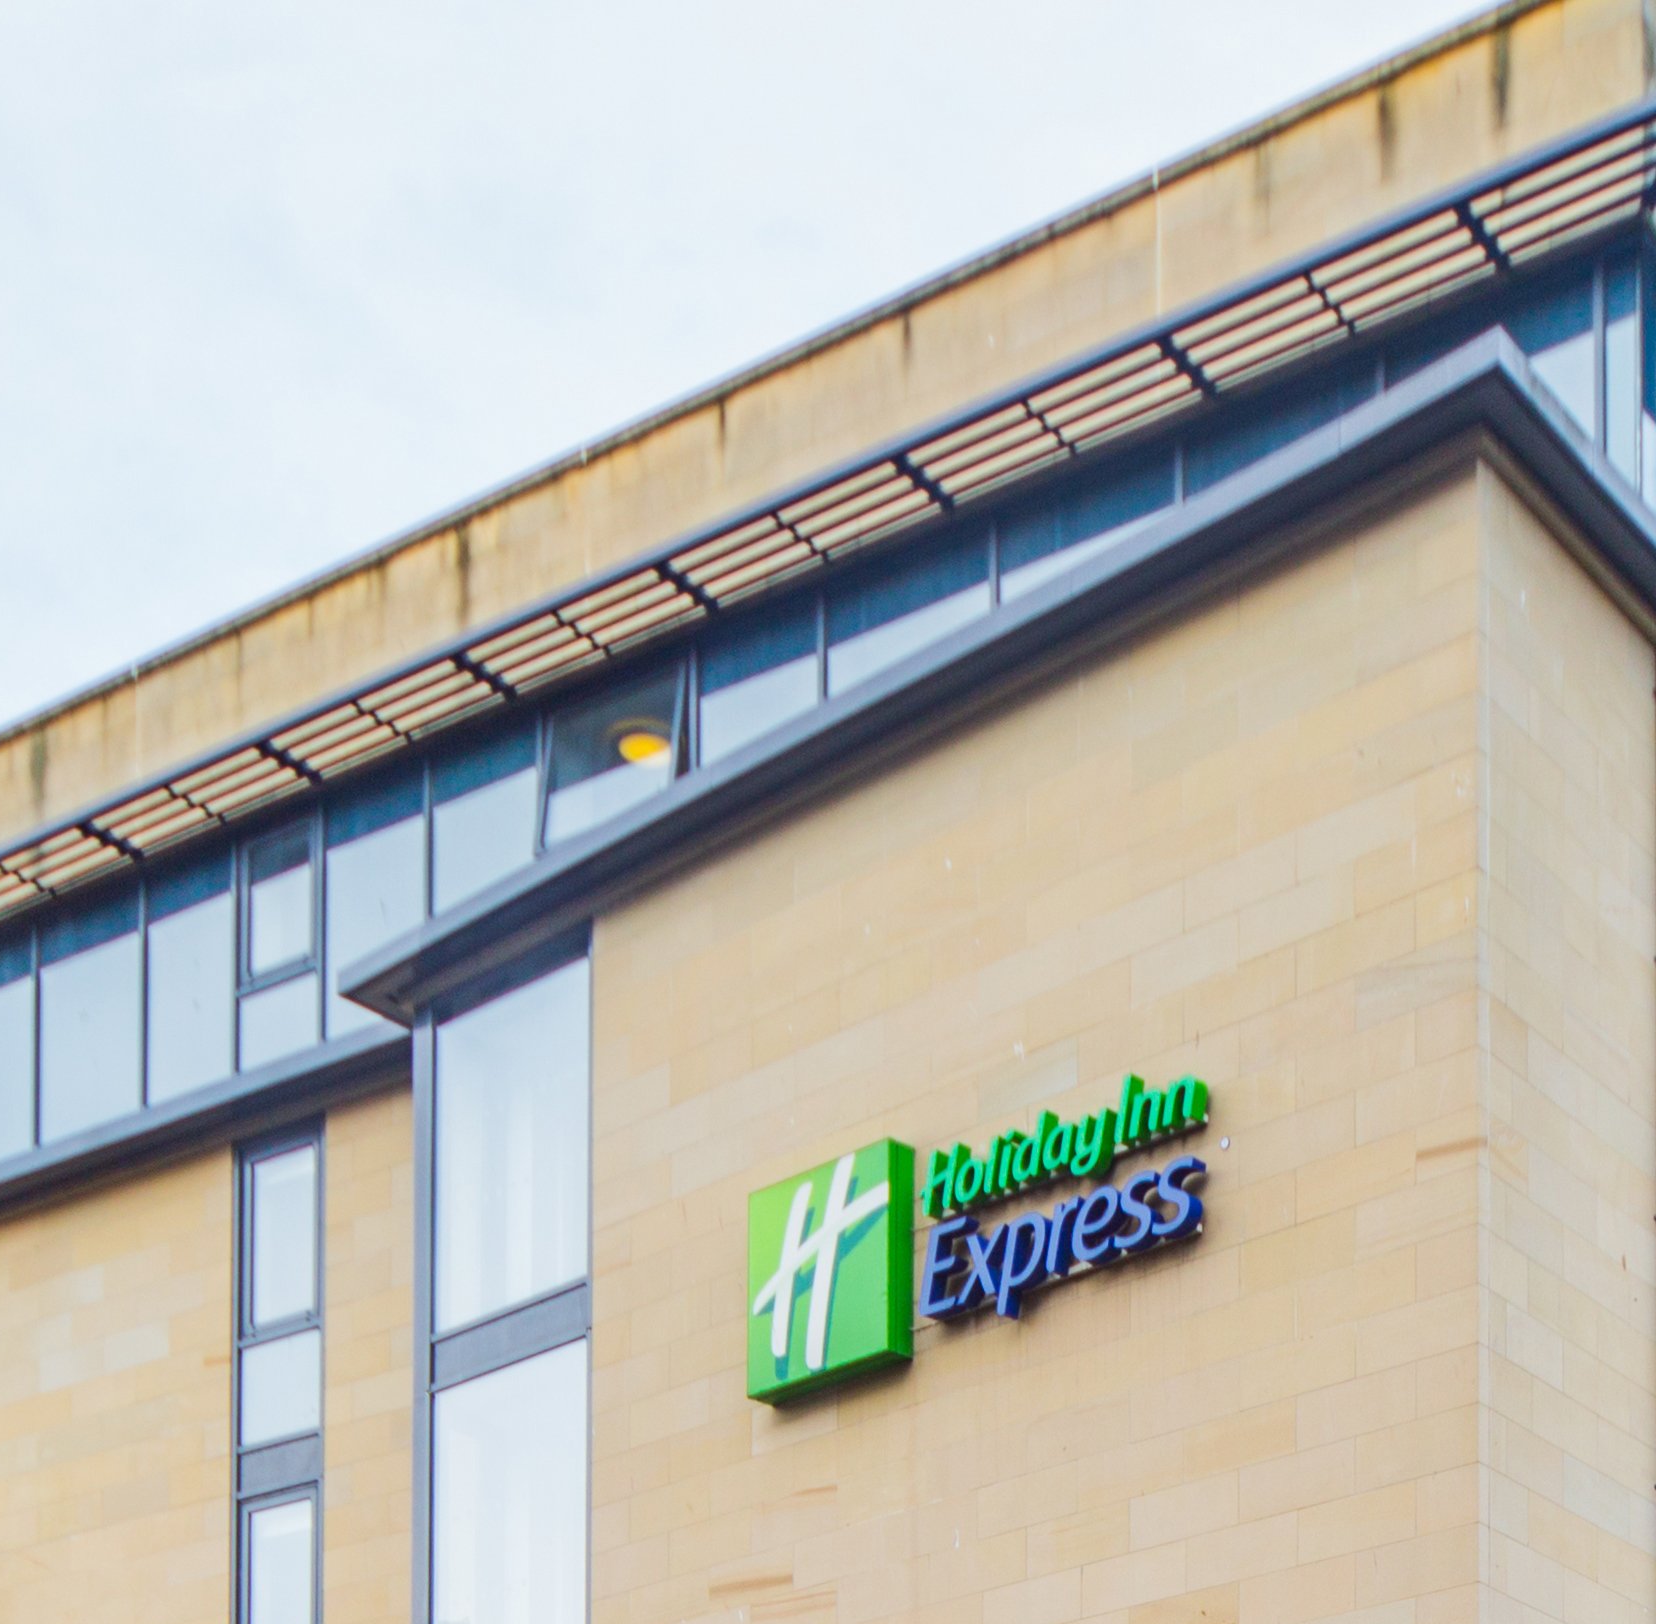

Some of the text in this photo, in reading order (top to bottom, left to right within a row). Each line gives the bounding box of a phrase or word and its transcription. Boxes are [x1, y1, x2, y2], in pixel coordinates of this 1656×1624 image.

[921, 1073, 1208, 1218] Holiday Inn
[919, 1156, 1206, 1319] Express
